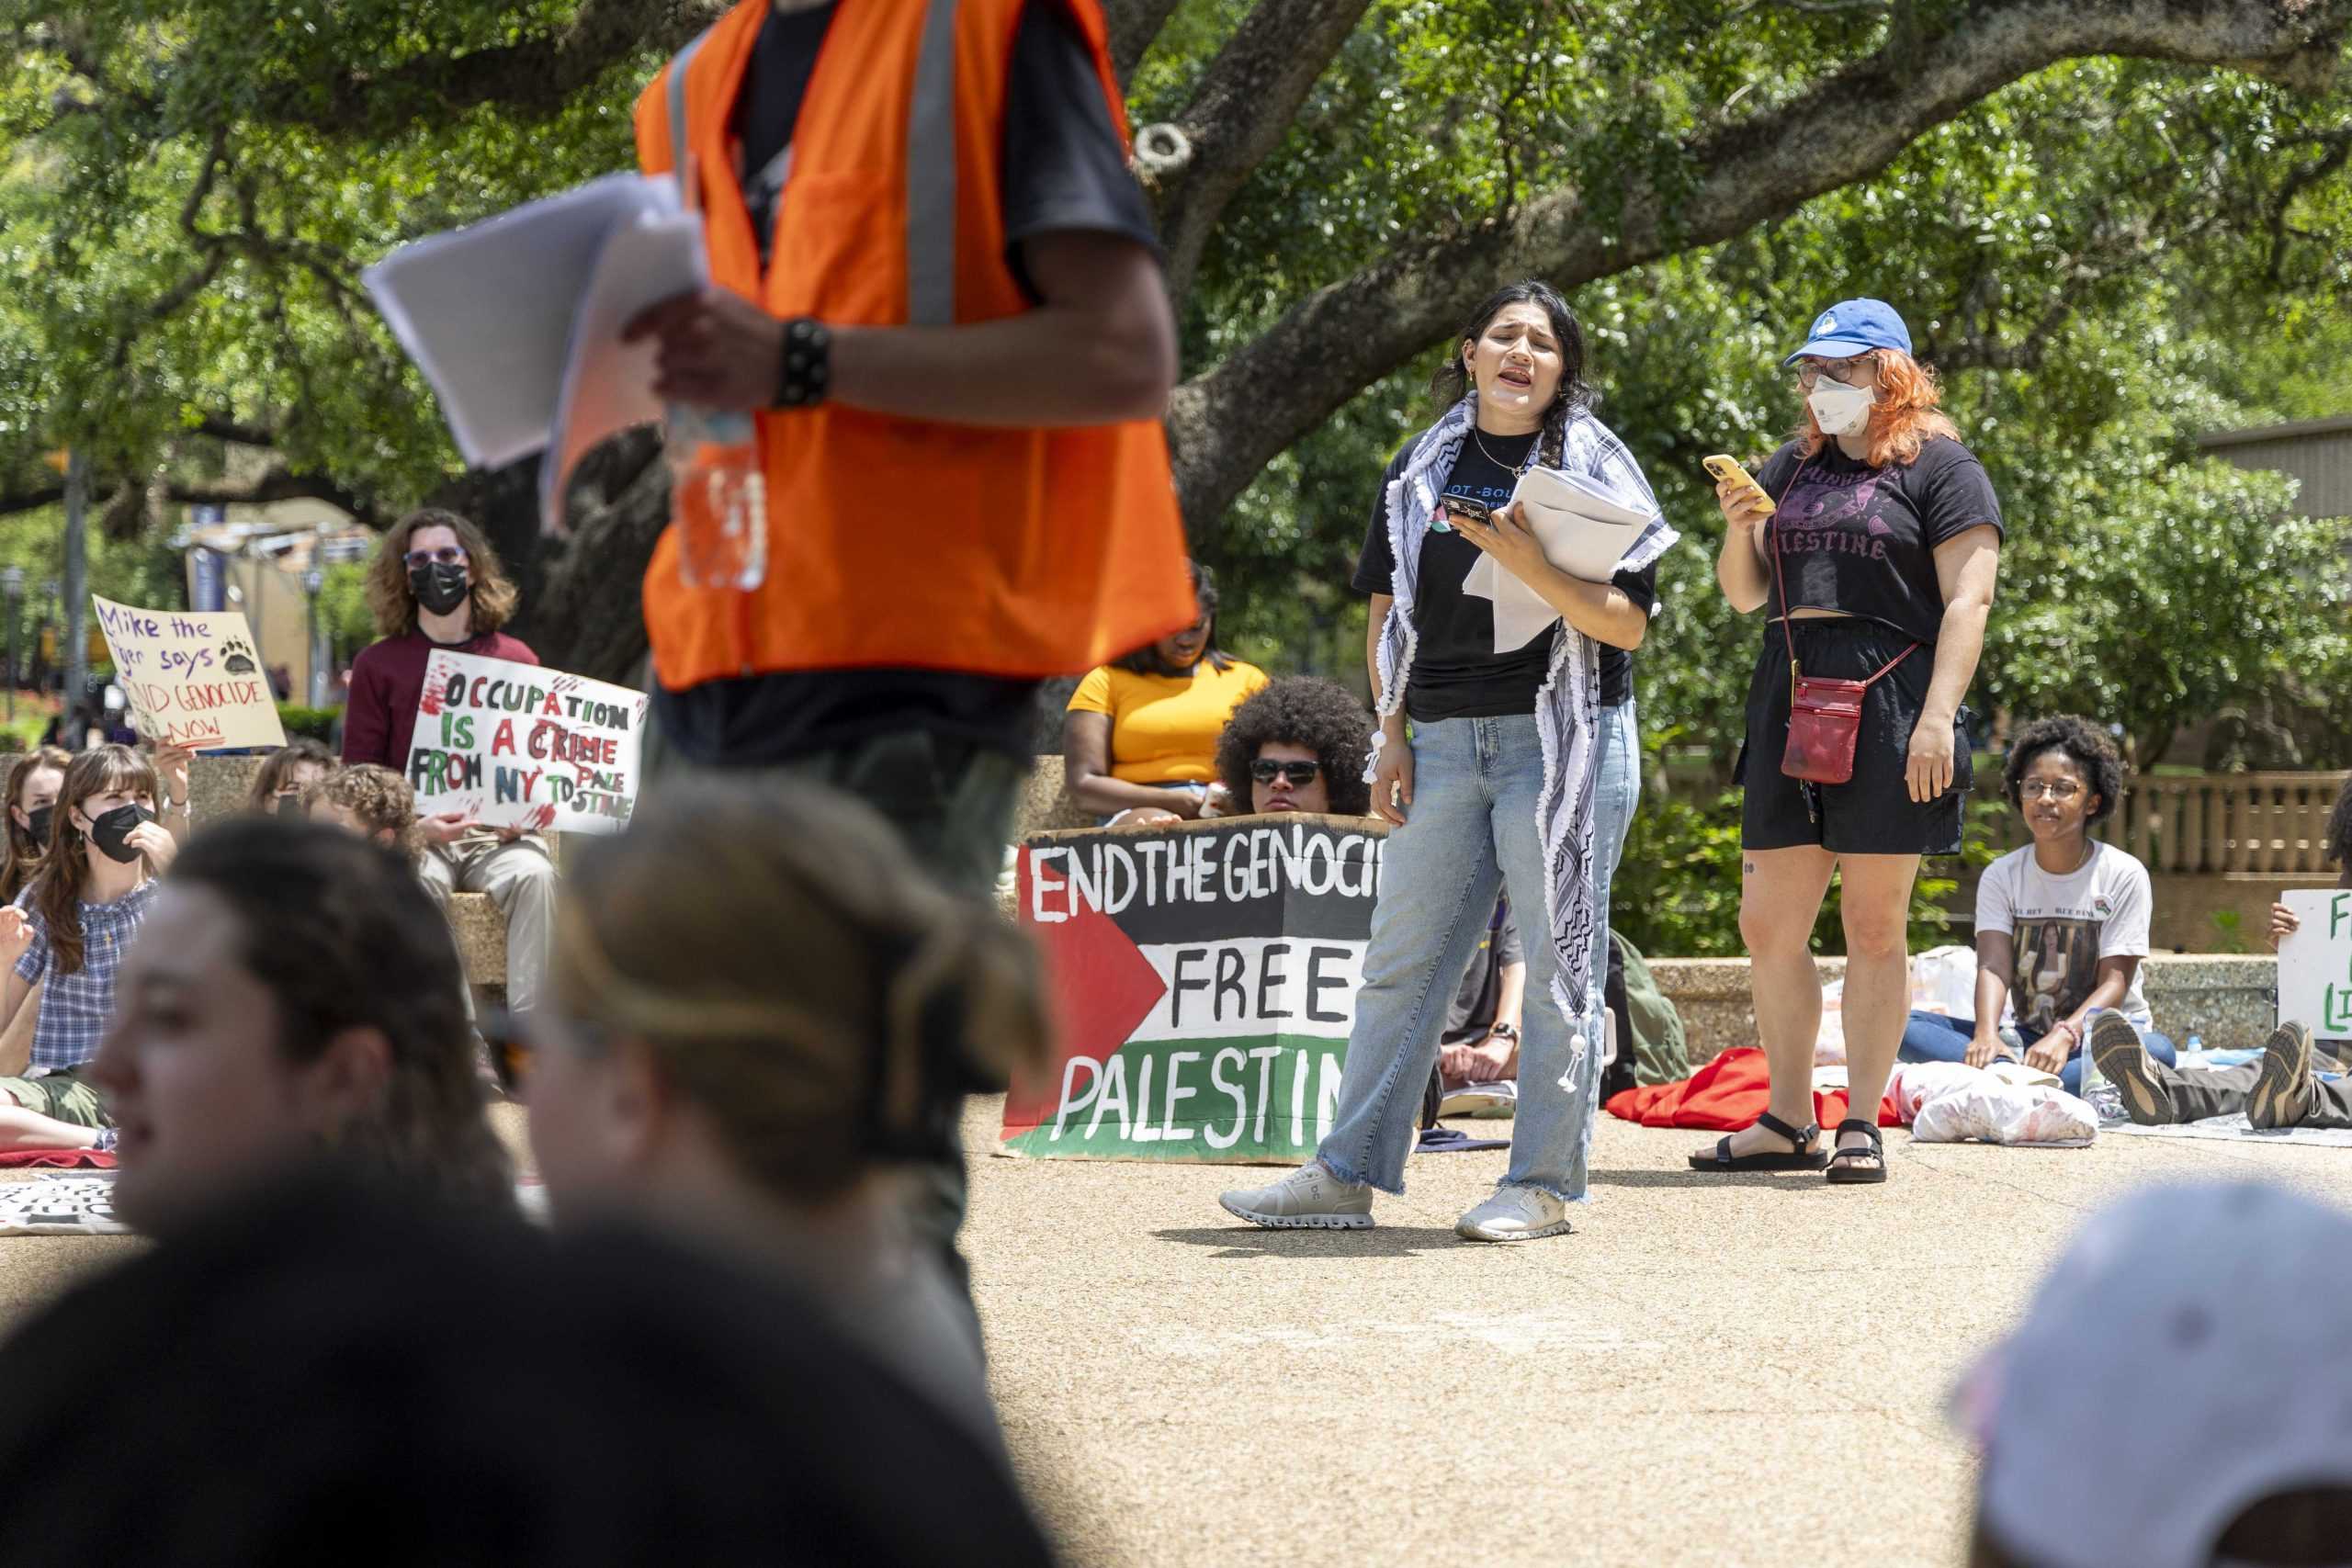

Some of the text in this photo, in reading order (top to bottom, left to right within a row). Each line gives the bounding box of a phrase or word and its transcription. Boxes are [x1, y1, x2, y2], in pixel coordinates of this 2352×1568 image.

[97, 604, 211, 638] Mike the
[161, 648, 213, 679] says
[175, 682, 266, 711] GENOCIDE
[445, 673, 628, 730] OCCUPATION
[166, 716, 220, 742] NOW
[441, 712, 618, 765] IS A CRIME
[411, 748, 482, 795] FROM
[494, 765, 543, 805] NY
[574, 764, 625, 793] PALE
[571, 791, 633, 820] STINE
[1029, 842, 1138, 923] END
[1135, 835, 1217, 906] THE
[2331, 893, 2352, 940] F
[1171, 944, 1353, 1029] FREE
[1049, 1046, 1342, 1149] PALESTIN
